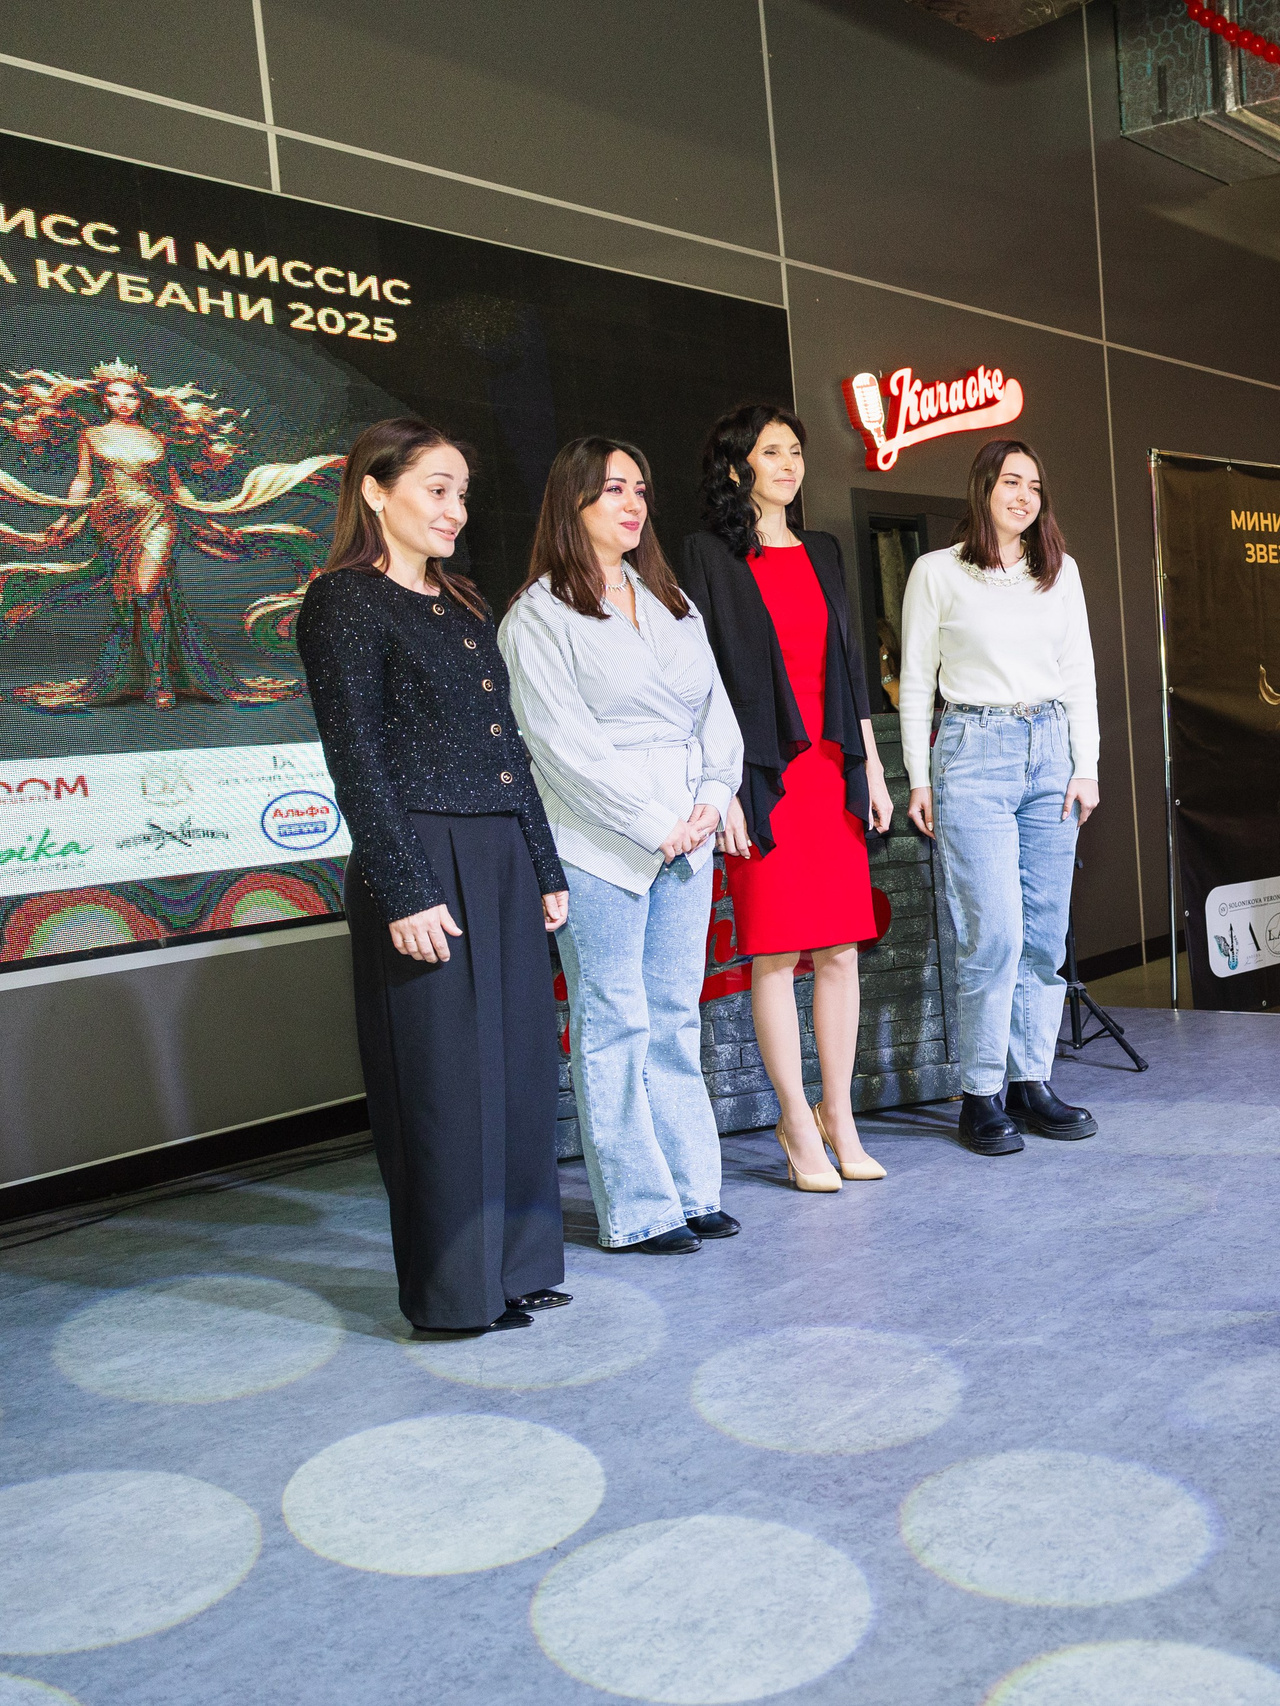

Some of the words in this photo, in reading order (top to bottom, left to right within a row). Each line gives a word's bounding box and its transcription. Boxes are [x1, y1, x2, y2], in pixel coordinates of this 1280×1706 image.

[0, 202, 120, 252] ИСС
[138, 230, 178, 265] И
[195, 241, 412, 305] МИССИС
[35, 259, 274, 325] КУБАНИ
[287, 302, 398, 343] 2025
[884, 365, 1010, 452] Karaoke
[0, 775, 89, 800] OM
[272, 806, 330, 819] Альфа
[1229, 898, 1262, 909] SOLONIKOVA
